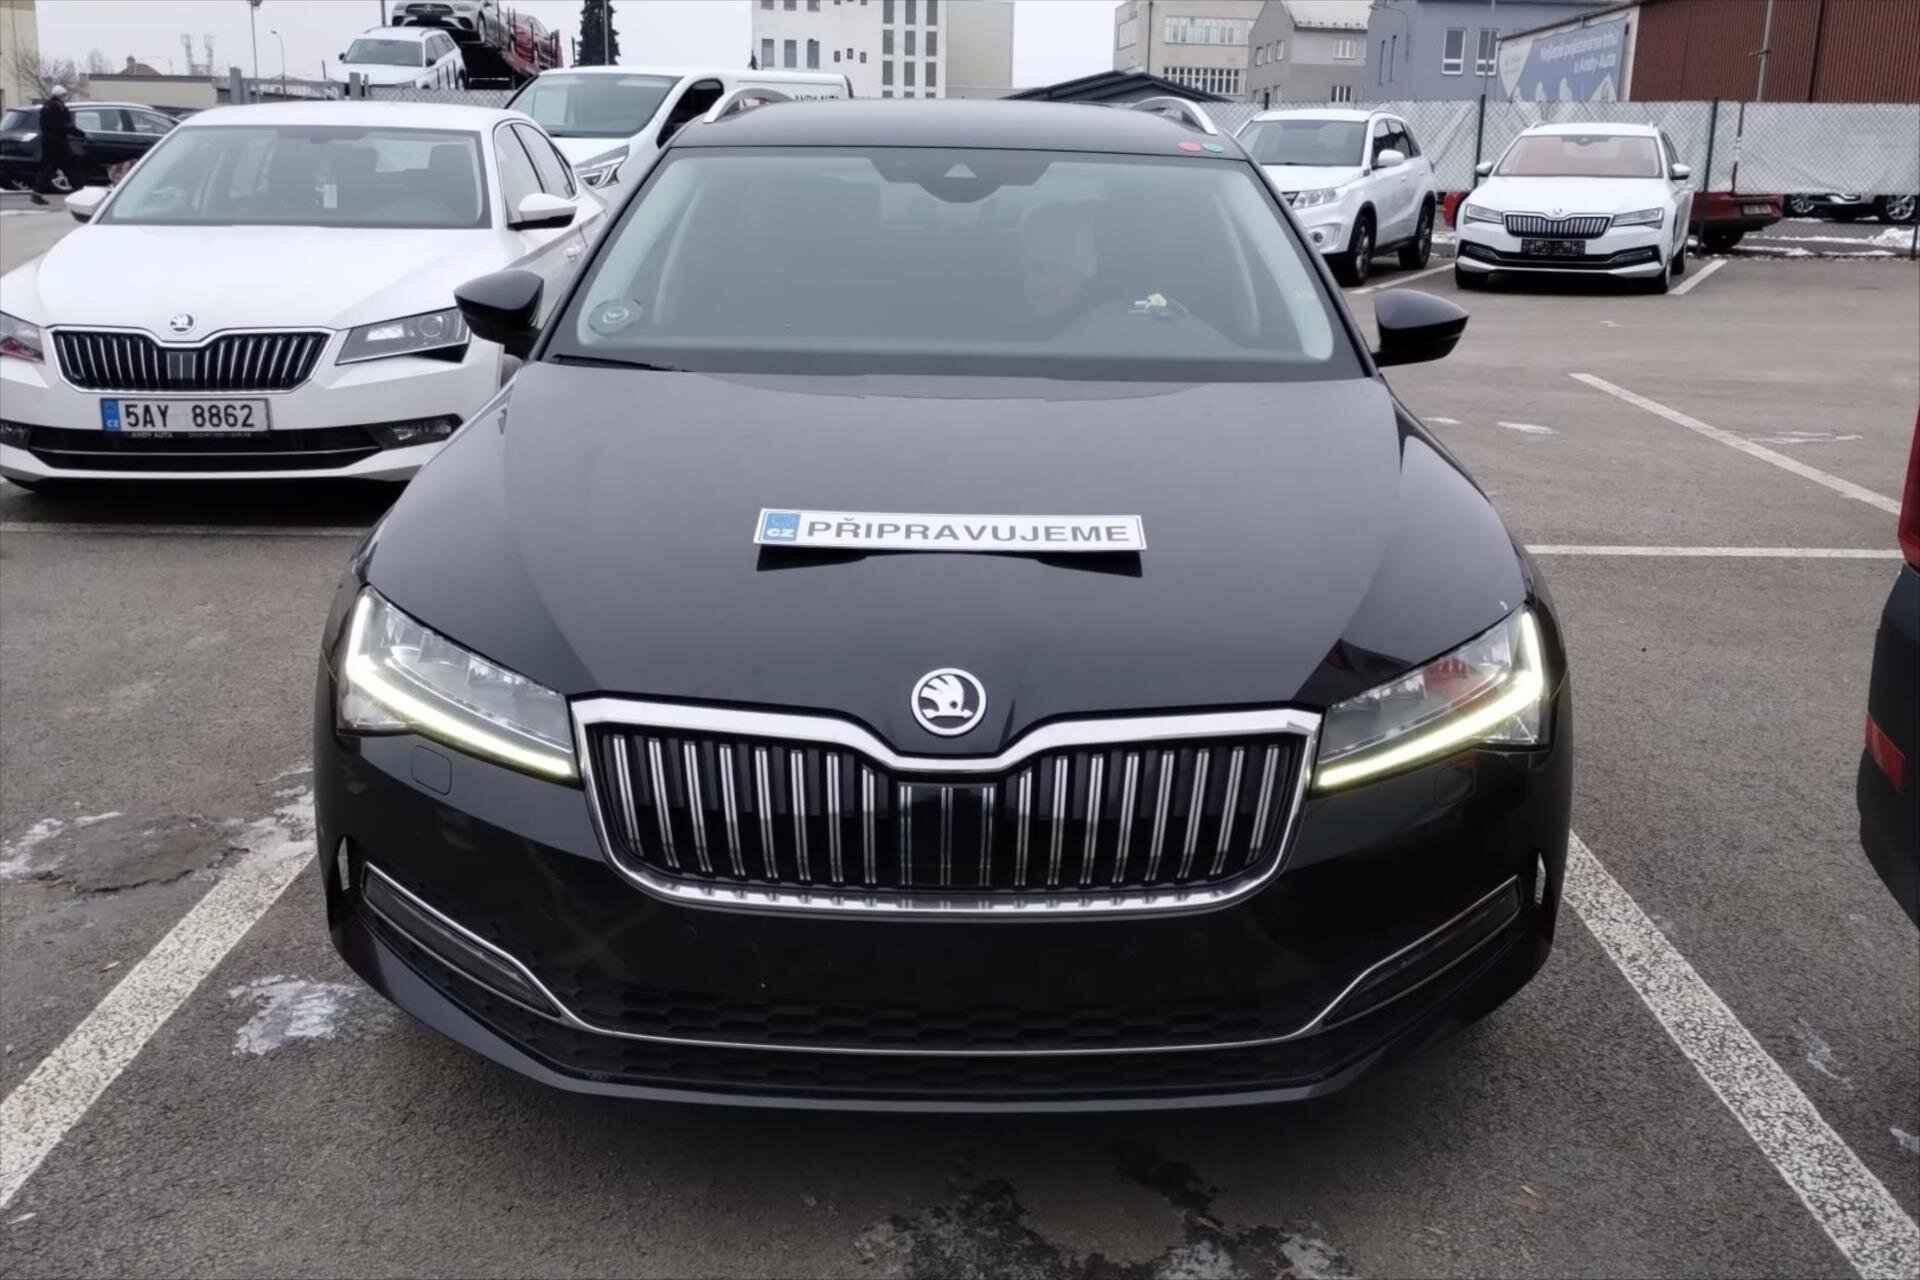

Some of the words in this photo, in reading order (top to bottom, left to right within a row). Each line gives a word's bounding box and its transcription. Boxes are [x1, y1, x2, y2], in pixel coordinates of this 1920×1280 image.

[107, 419, 119, 428] CZ
[125, 404, 169, 428] 5AY
[191, 404, 255, 428] 8862
[767, 528, 794, 537] CZ
[807, 517, 1130, 542] PŘIPRAVUJEME
